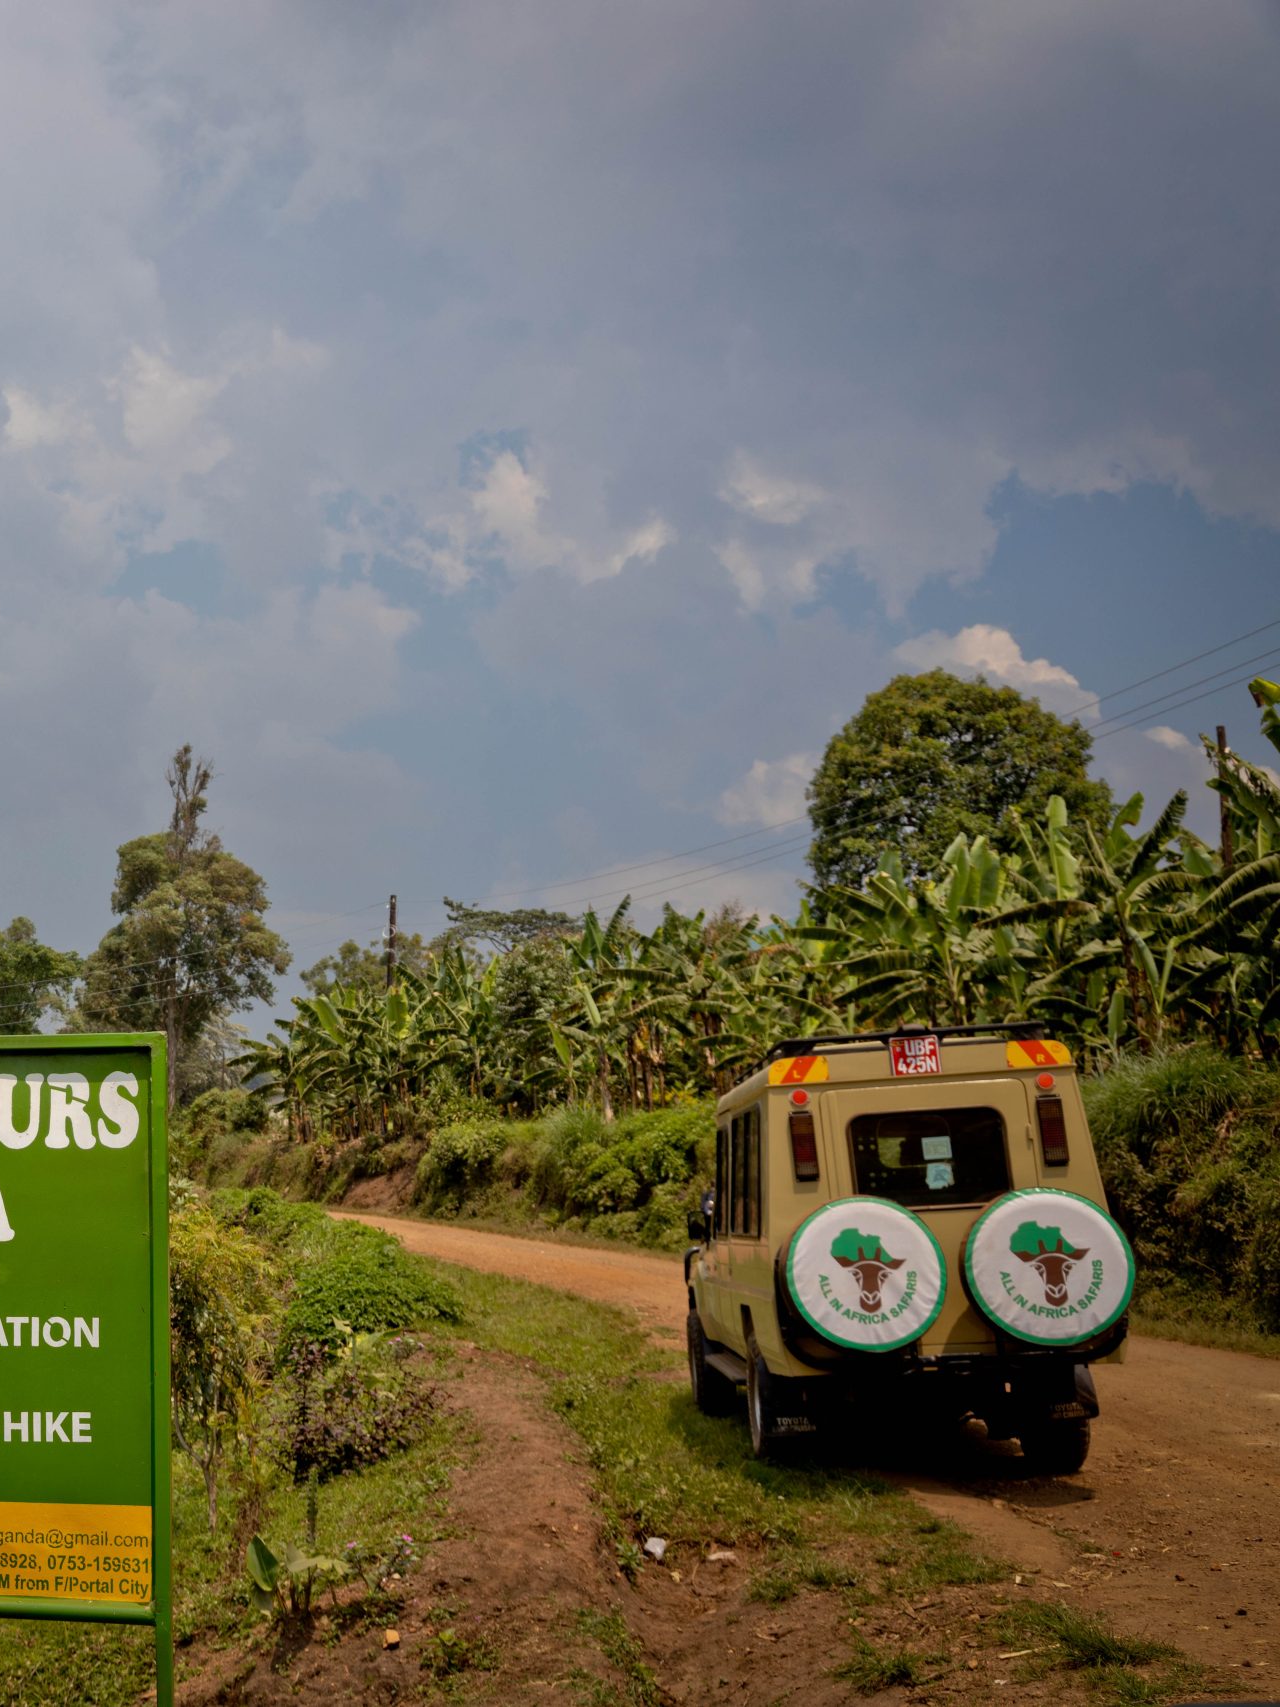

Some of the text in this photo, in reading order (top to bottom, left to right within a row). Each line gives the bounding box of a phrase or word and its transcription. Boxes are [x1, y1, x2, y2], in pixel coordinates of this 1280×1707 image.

[904, 1038, 934, 1056] UBF
[1036, 1053, 1045, 1063] R
[897, 1055, 937, 1074] 425N
[818, 1270, 918, 1325] ALL IN AFRICA SAFARIS
[999, 1259, 1103, 1319] ALL IN AFRICA SAFARIS
[3, 1411, 92, 1443] HIKE
[47, 1555, 149, 1574] 0753-159631
[14, 1574, 49, 1591] from
[54, 1576, 114, 1594] F/Portal
[119, 1578, 149, 1599] City
